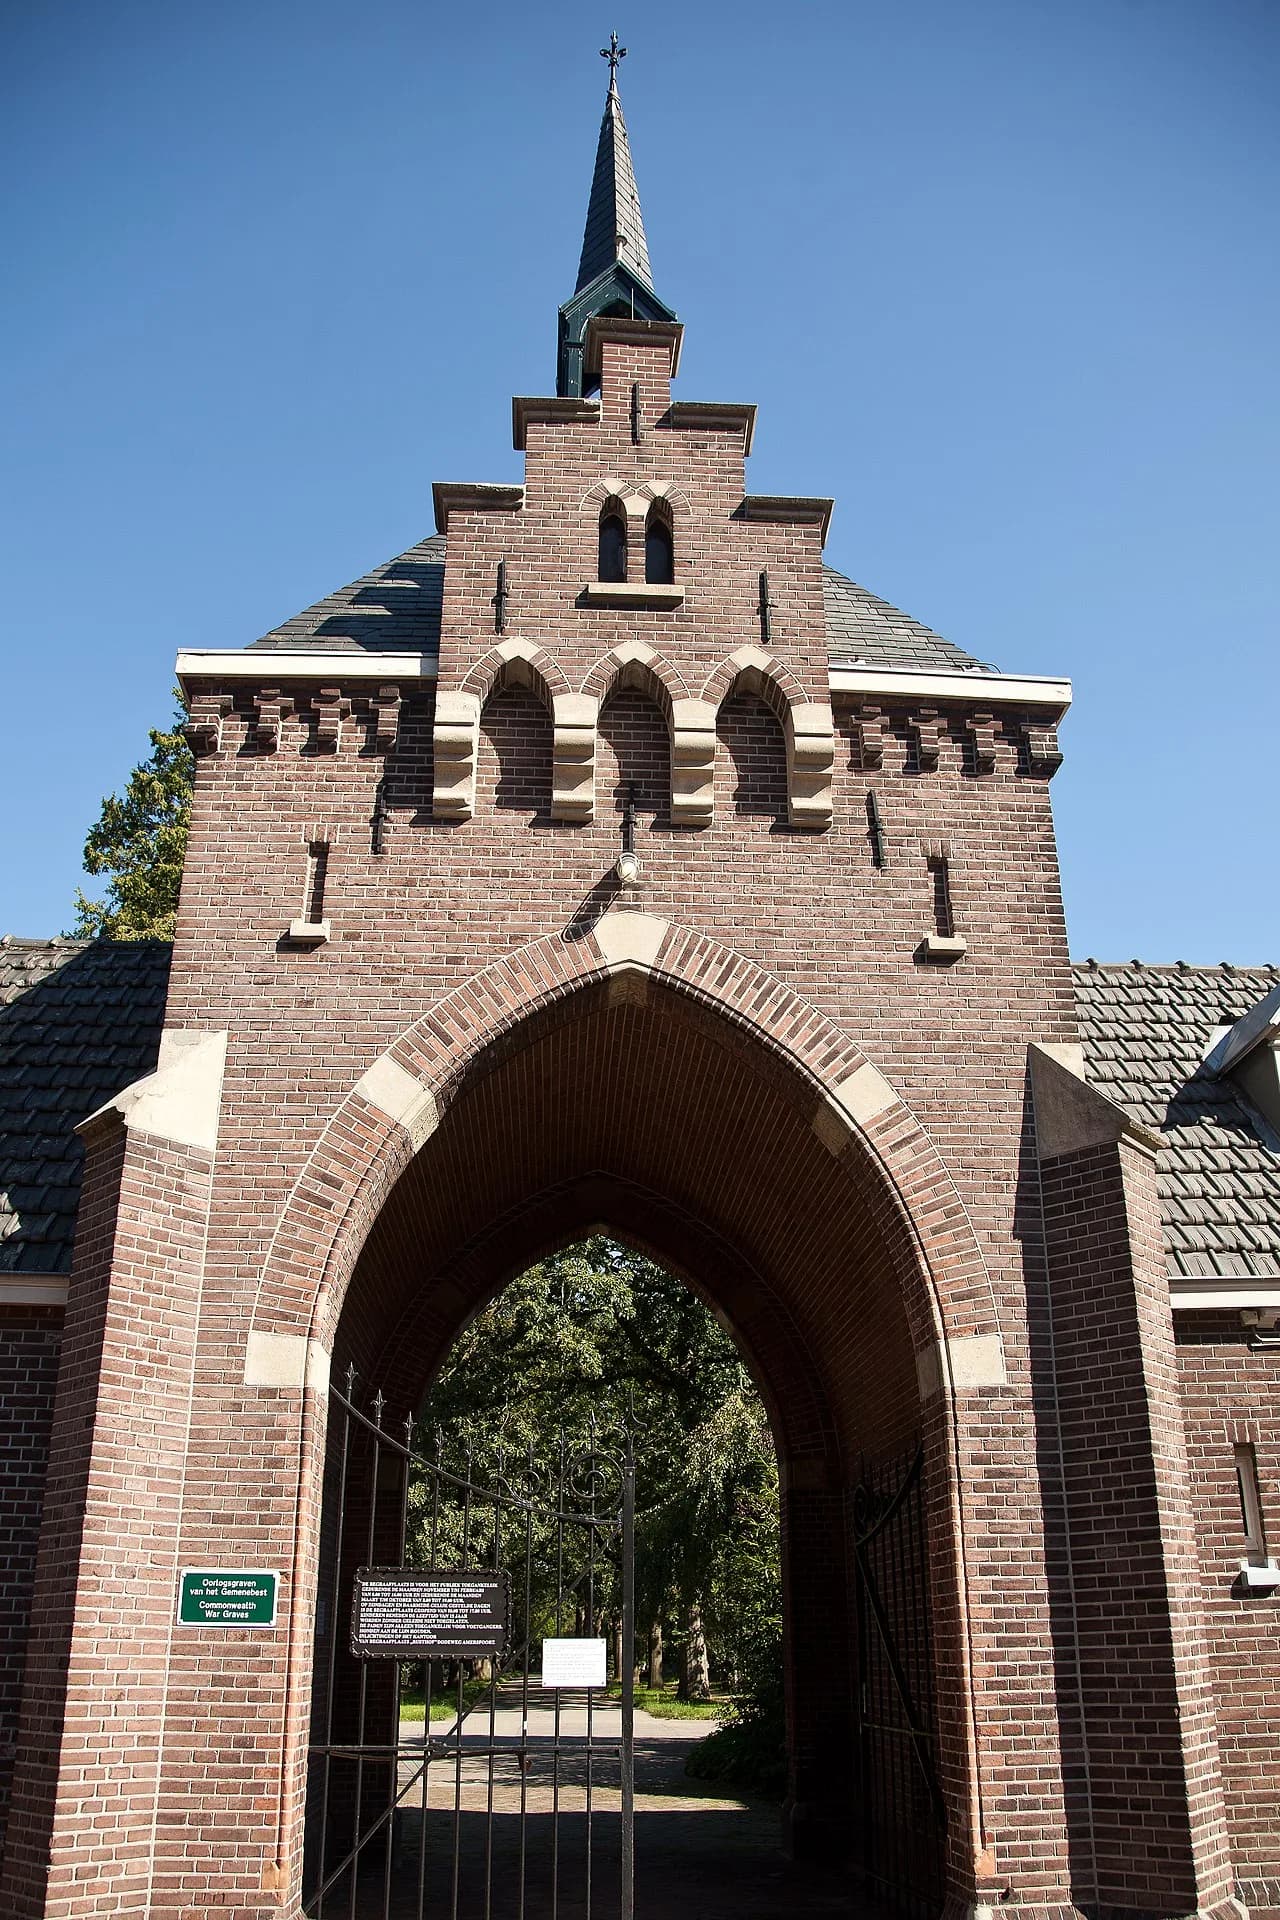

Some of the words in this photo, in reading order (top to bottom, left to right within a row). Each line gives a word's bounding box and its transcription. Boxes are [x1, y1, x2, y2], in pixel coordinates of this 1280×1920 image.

[202, 1578, 256, 1588] Oorlogsgraven
[199, 1601, 256, 1610] Commonwealth
[205, 1610, 220, 1618] War
[222, 1610, 249, 1618] Graves
